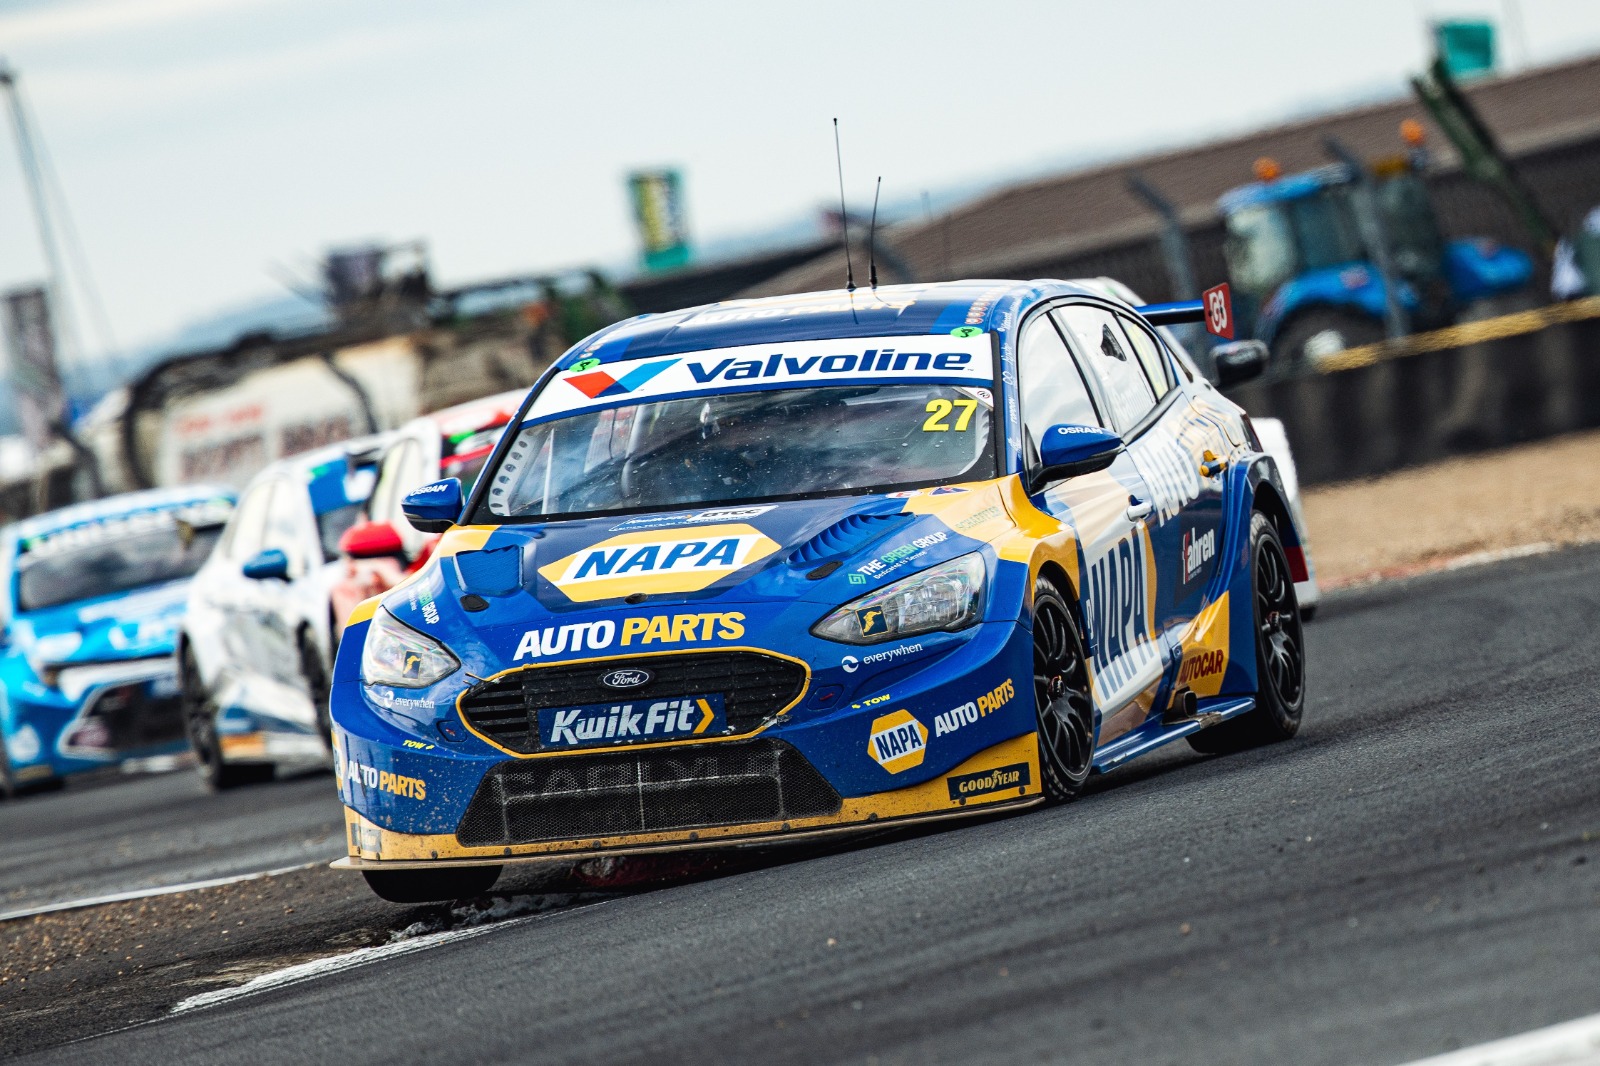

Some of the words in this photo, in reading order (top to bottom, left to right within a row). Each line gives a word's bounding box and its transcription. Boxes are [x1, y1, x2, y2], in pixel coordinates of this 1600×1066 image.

[687, 348, 973, 384] Valvoline
[922, 399, 978, 432] 27
[1057, 426, 1104, 435] OSRAM
[409, 484, 449, 497] OSRAM
[573, 538, 740, 579] NAPA
[857, 558, 887, 576] THE
[881, 543, 919, 564] GREEN
[912, 531, 949, 549] GROUP
[421, 601, 440, 625] GROUP
[1091, 525, 1155, 701] NAPA
[512, 620, 616, 661] AUTO
[620, 611, 746, 646] PARTS
[863, 643, 923, 664] everywhen
[1177, 649, 1224, 686] AUTOCAR
[612, 672, 640, 686] Ford
[395, 697, 435, 710] everywhen
[863, 694, 891, 706] TOW
[934, 701, 979, 738] AUTO
[977, 678, 1015, 717] PARTS
[402, 739, 426, 749] TOW
[876, 722, 923, 760] NAPA
[348, 760, 379, 789] AUTO
[379, 770, 427, 801] PARTS
[958, 769, 1020, 793] GOODYEAR
